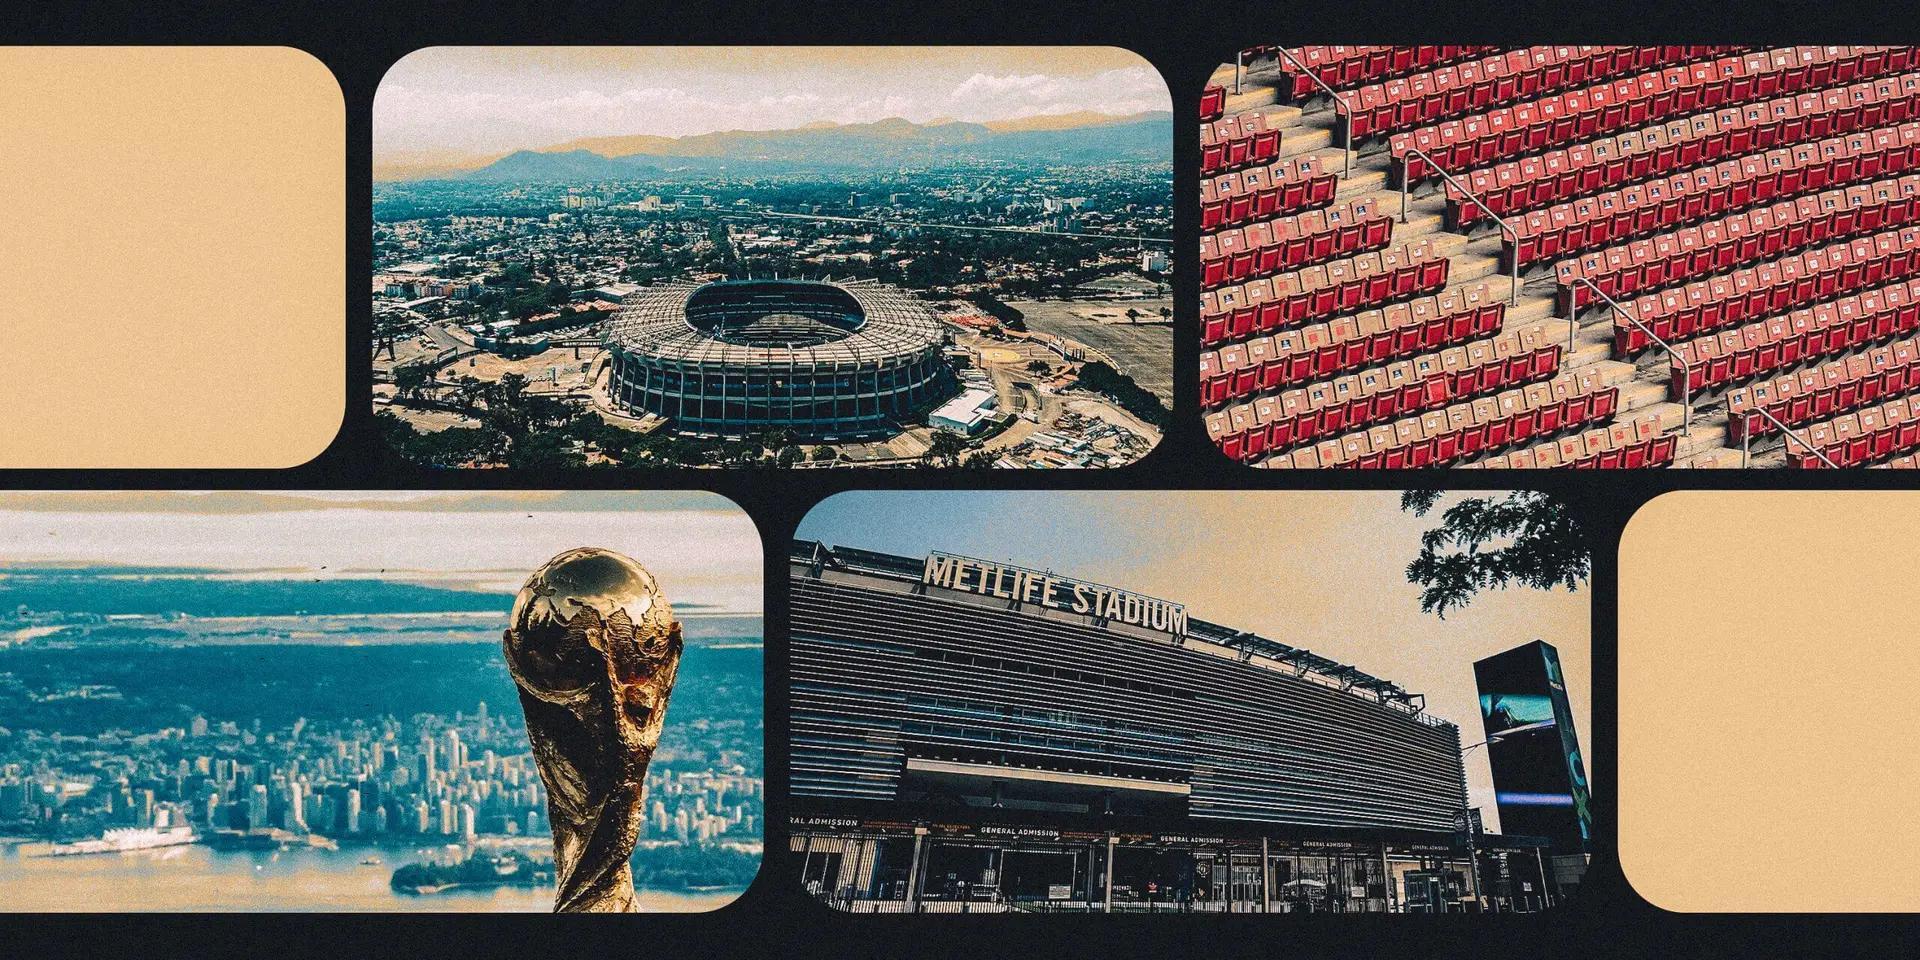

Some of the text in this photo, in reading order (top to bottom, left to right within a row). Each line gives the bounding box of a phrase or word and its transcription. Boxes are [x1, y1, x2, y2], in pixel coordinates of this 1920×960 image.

[923, 554, 1189, 636] METLIFE STADIUM
[808, 818, 858, 826] ADMISSION
[981, 827, 1016, 835] GENERAL
[1018, 829, 1059, 837] ADMISSION
